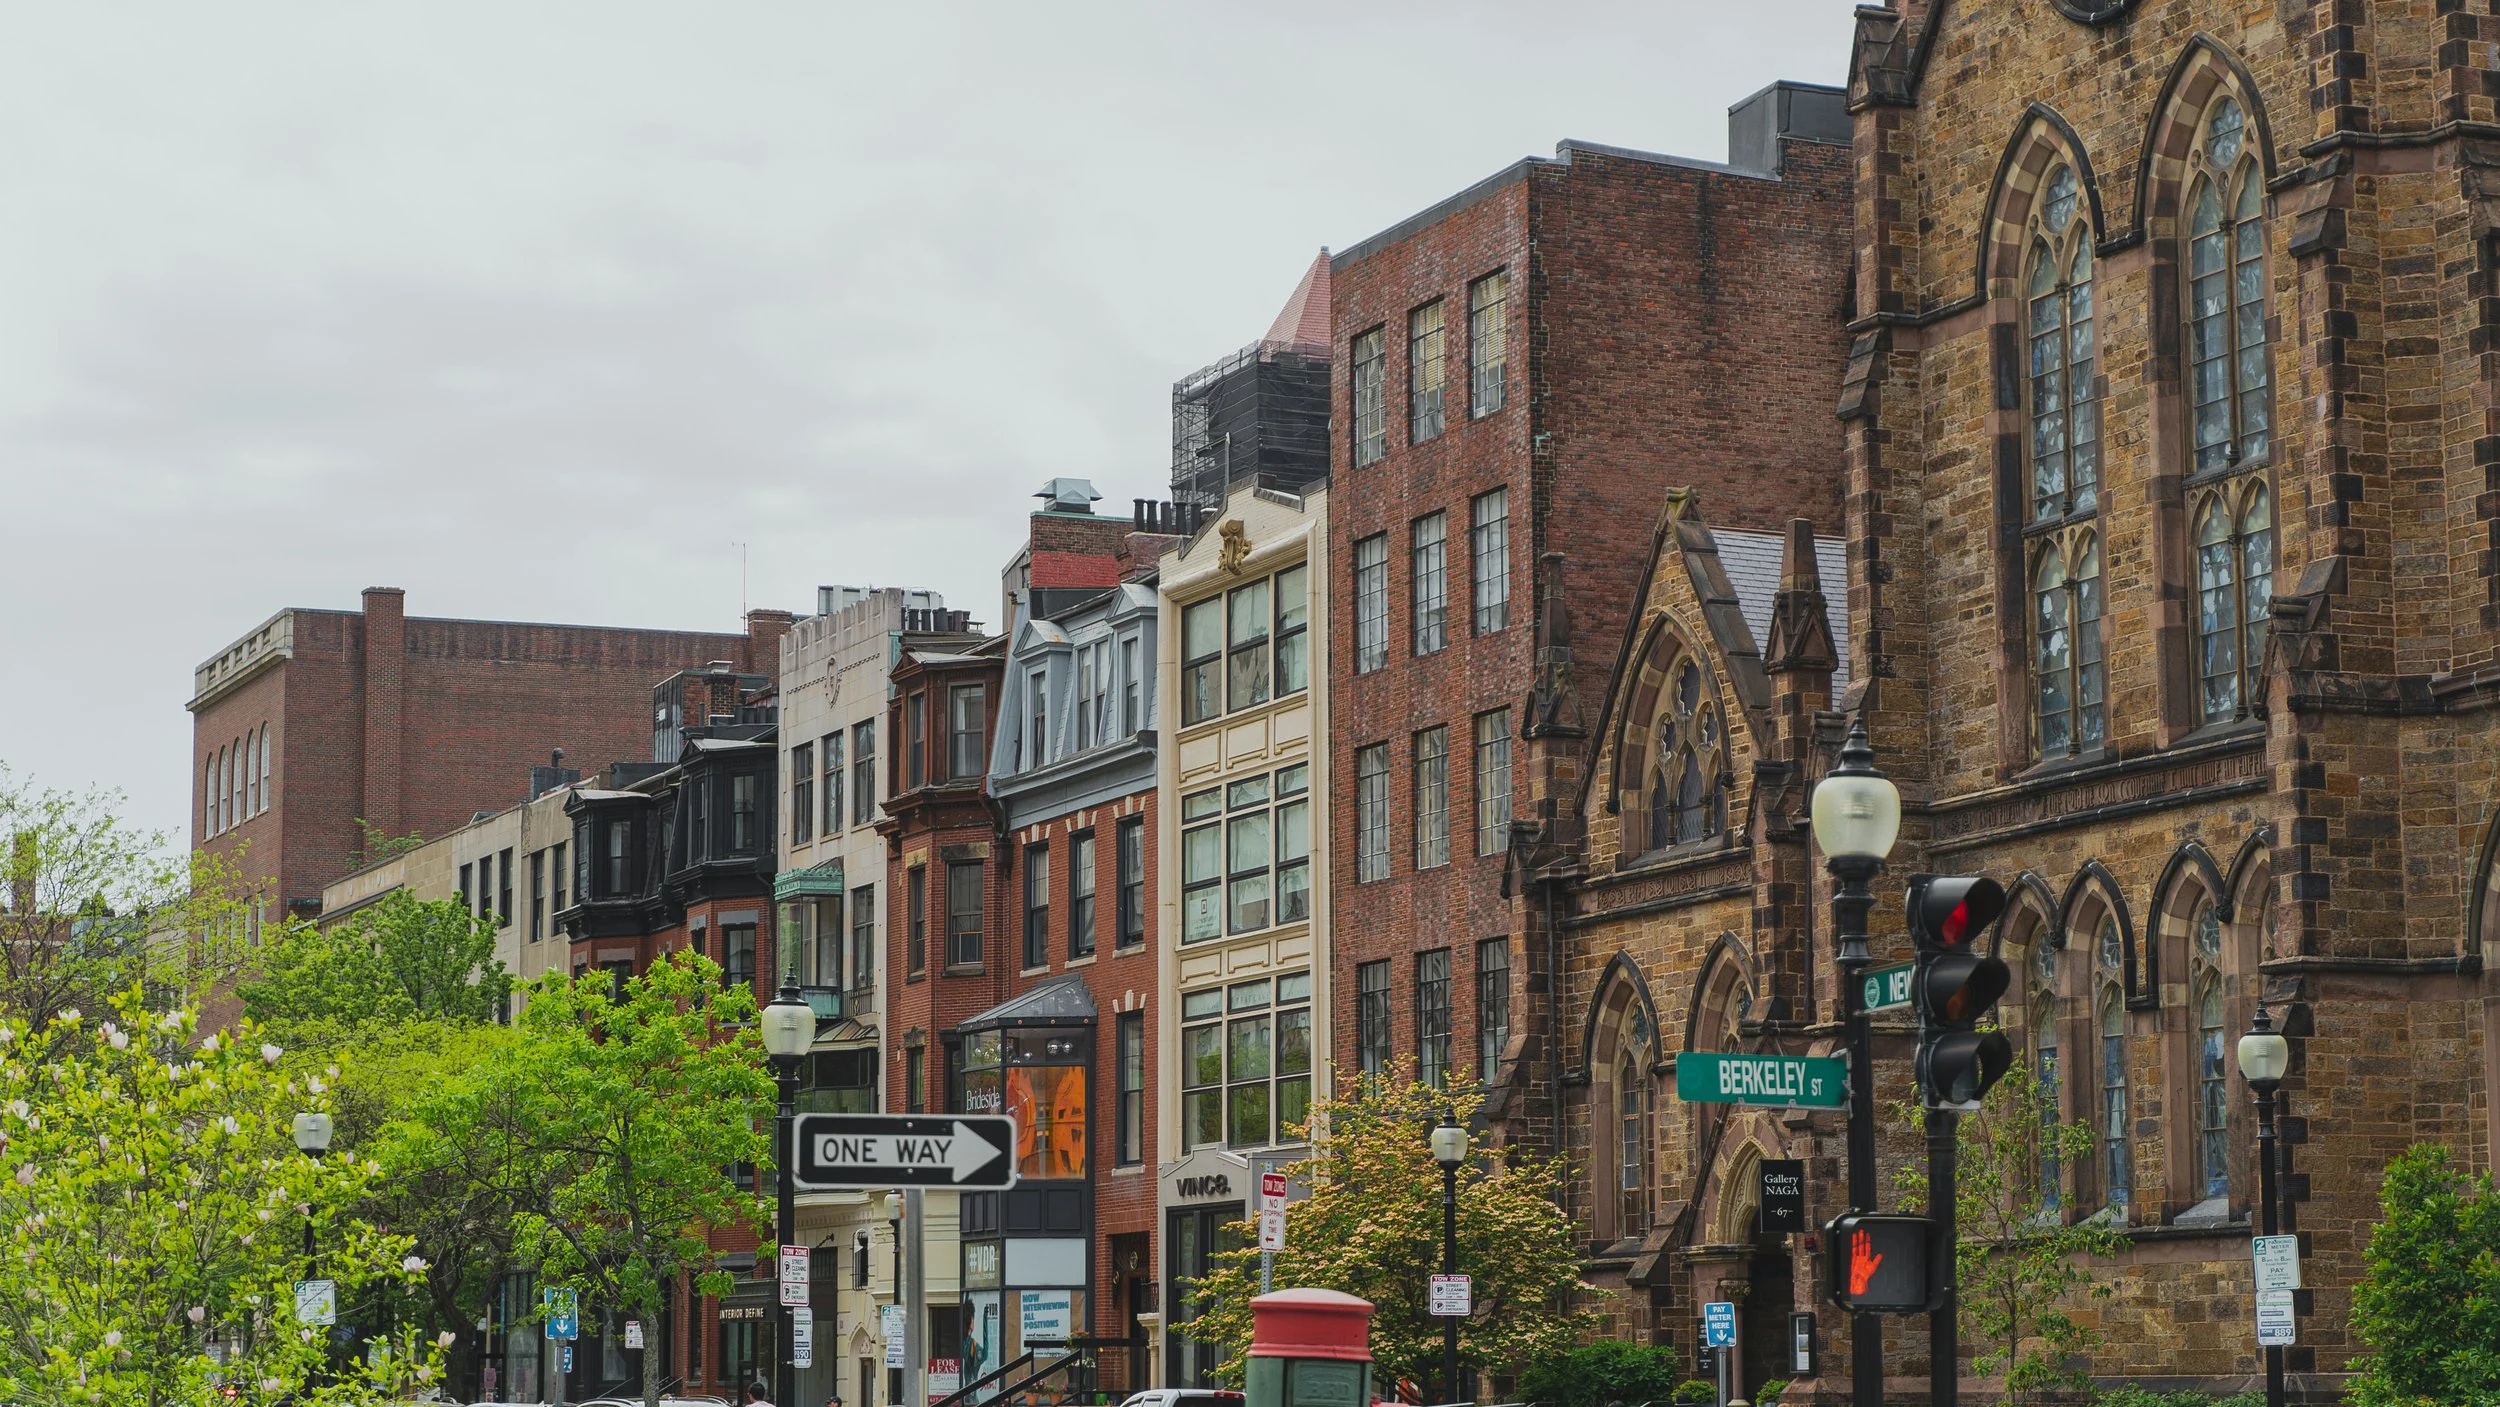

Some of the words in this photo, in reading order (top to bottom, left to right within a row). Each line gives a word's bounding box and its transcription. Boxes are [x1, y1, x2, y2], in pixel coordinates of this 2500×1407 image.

[1719, 1060, 1806, 1096] BERKELEY
[1811, 1078, 1823, 1096] ST
[966, 1086, 1001, 1110] Brideside
[823, 1138, 877, 1163] ONE
[896, 1139, 952, 1163] WAY
[1764, 1174, 1799, 1186] Gallery
[1264, 1179, 1273, 1191] TOW
[1273, 1180, 1285, 1193] ZONE
[1765, 1185, 1800, 1195] NAGA
[1269, 1198, 1279, 1209] NO
[1264, 1209, 1283, 1218] STOPPING
[1268, 1218, 1277, 1226] ANY
[1268, 1226, 1278, 1234] TIME
[2255, 1240, 2265, 1251] 2
[783, 1247, 794, 1256] TOW
[795, 1248, 808, 1257] ZONE
[1022, 1293, 1040, 1303] NOW
[1022, 1301, 1069, 1312] INTERVIEWING
[1712, 1305, 1726, 1313] PAY
[719, 1309, 744, 1319] INTERIOR
[745, 1307, 764, 1318] DEFINE
[1024, 1312, 1035, 1321] ALL
[1708, 1313, 1732, 1321] METER
[1024, 1319, 1059, 1330] POSITIONS
[1711, 1321, 1730, 1329] HERE
[2274, 1328, 2292, 1337] 889
[936, 1358, 955, 1367] FOR
[930, 1365, 960, 1374] LEASE
